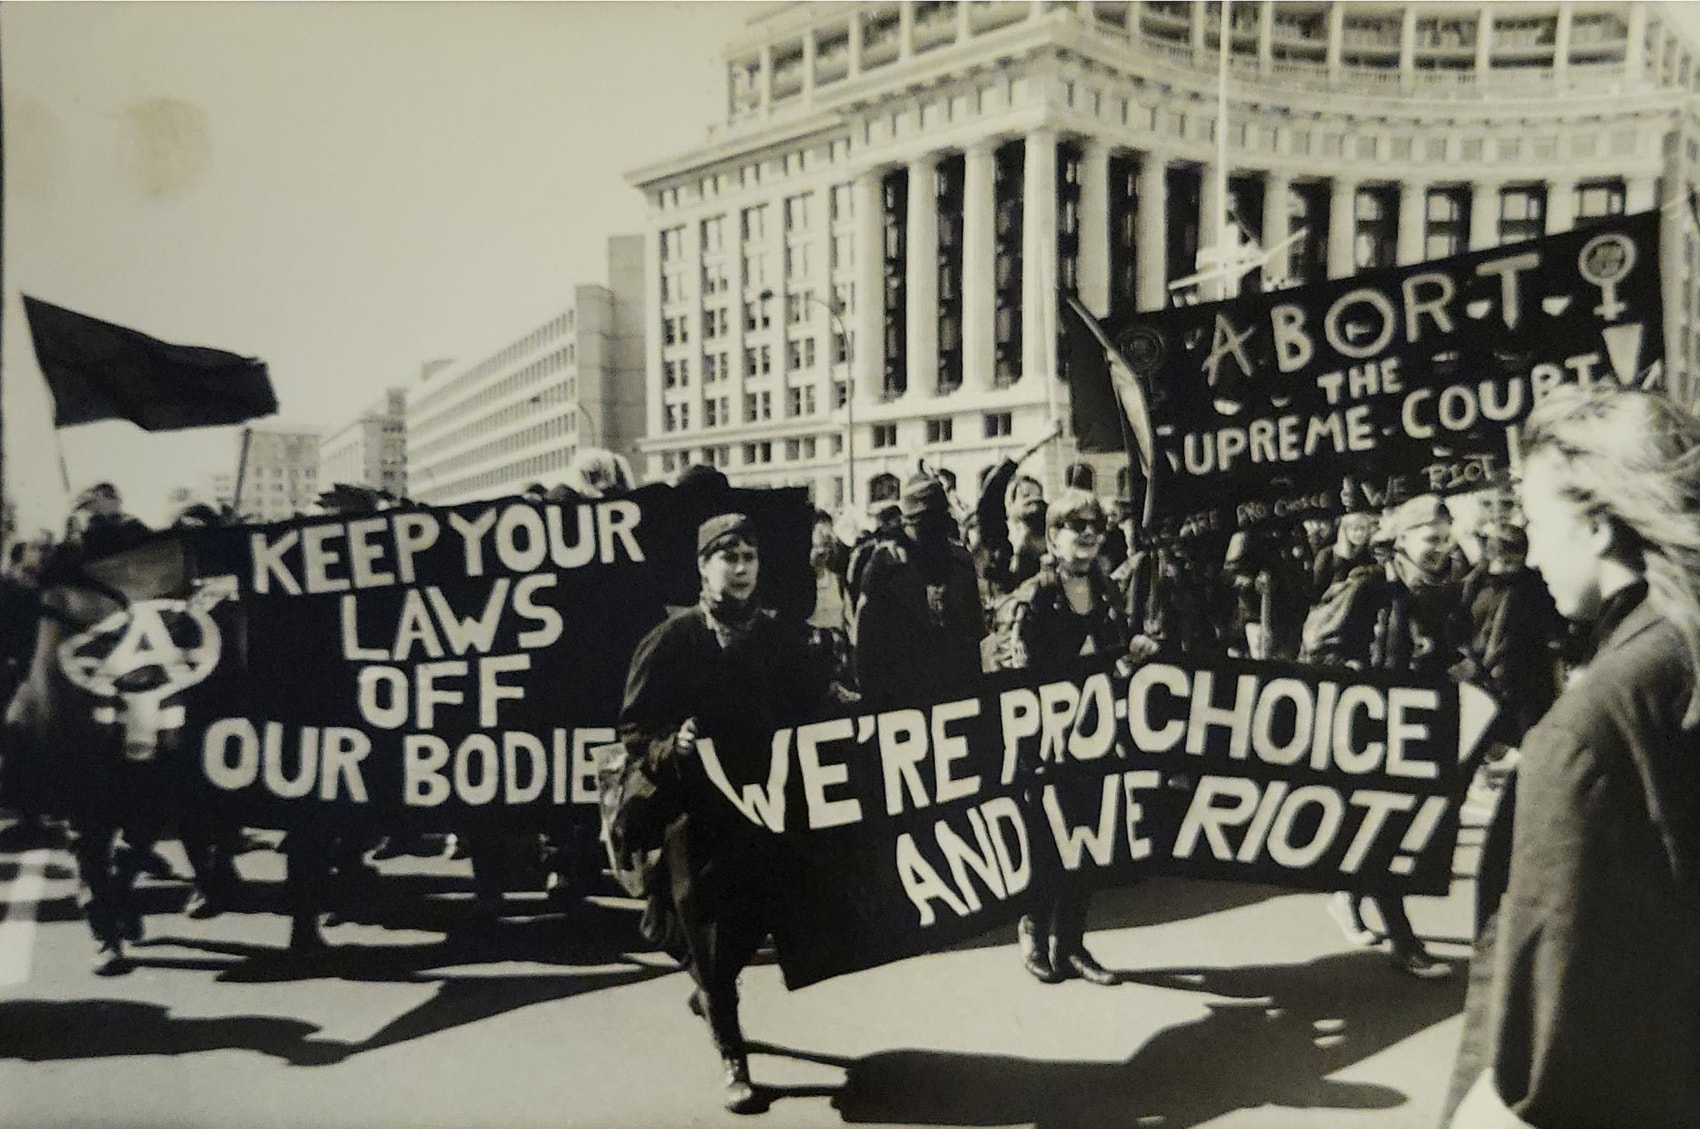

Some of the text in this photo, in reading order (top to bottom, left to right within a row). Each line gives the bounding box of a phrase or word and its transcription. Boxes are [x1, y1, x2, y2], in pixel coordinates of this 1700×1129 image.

[1316, 357, 1402, 405] THE
[250, 500, 645, 596] KEEP YOUR
[341, 573, 564, 661] LAWS
[357, 654, 532, 730] OFF
[203, 717, 372, 803] OUR
[695, 698, 982, 834] WE'RE
[896, 770, 1448, 927] AND WE RIOT!
